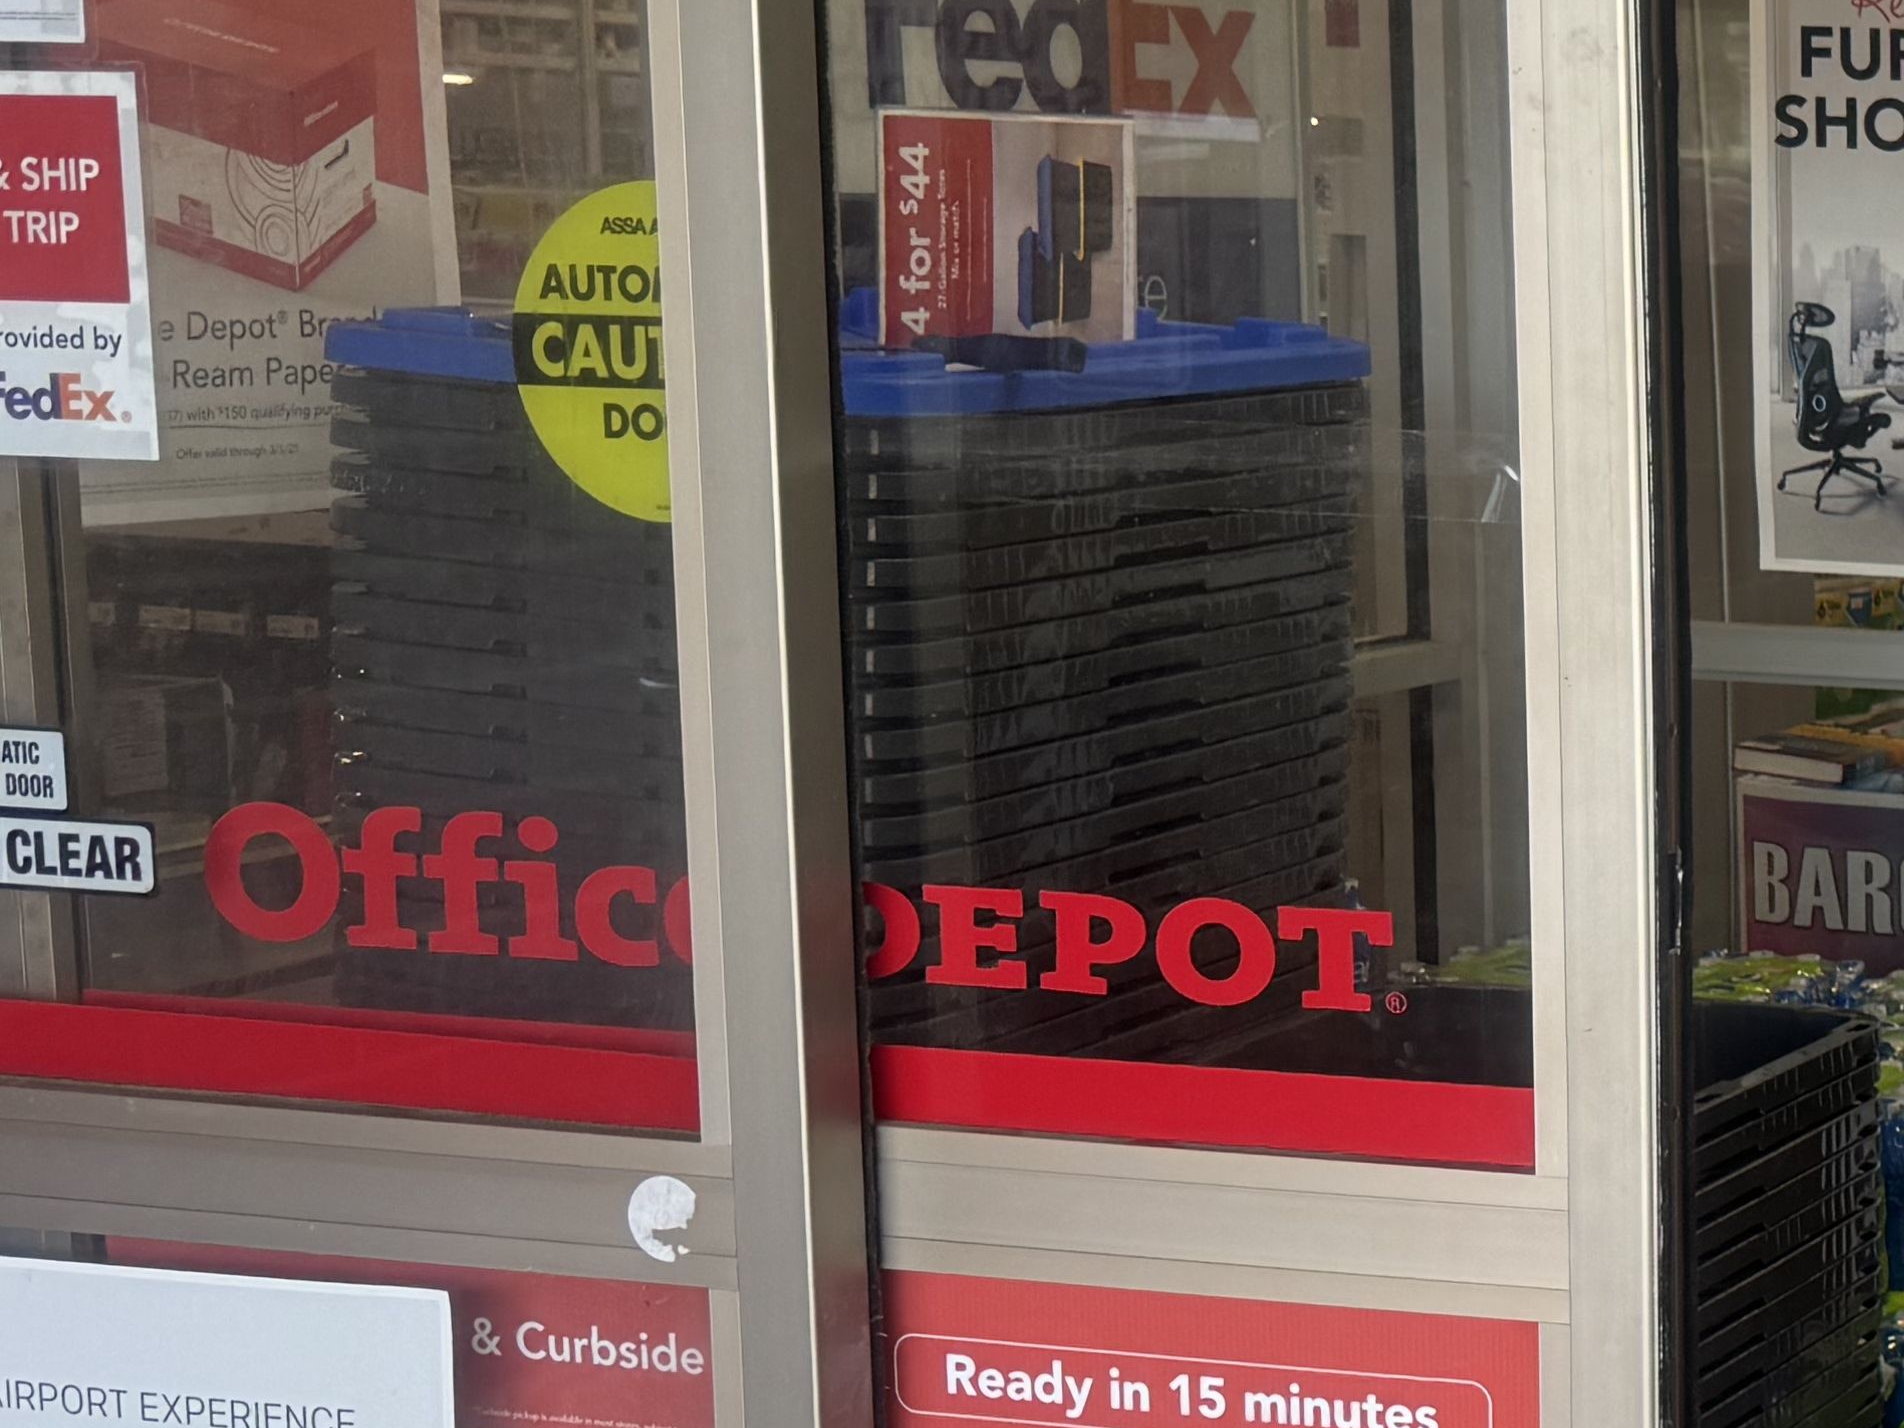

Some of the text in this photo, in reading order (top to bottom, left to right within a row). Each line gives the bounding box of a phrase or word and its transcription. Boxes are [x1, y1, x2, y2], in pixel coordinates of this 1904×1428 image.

[22, 157, 100, 193] SHIP
[4, 210, 80, 245] TRIP
[600, 216, 647, 235] ASSA
[898, 142, 932, 336] 4 for $44
[93, 325, 122, 355] by
[172, 359, 255, 389] Ream
[1, 739, 40, 767] ATIC
[4, 774, 55, 801] DOOR
[6, 828, 142, 882] CLEAR
[471, 1317, 705, 1376] & Curbside
[945, 1352, 1093, 1418] Ready
[1110, 1368, 1150, 1412] in
[1169, 1374, 1227, 1419] 15
